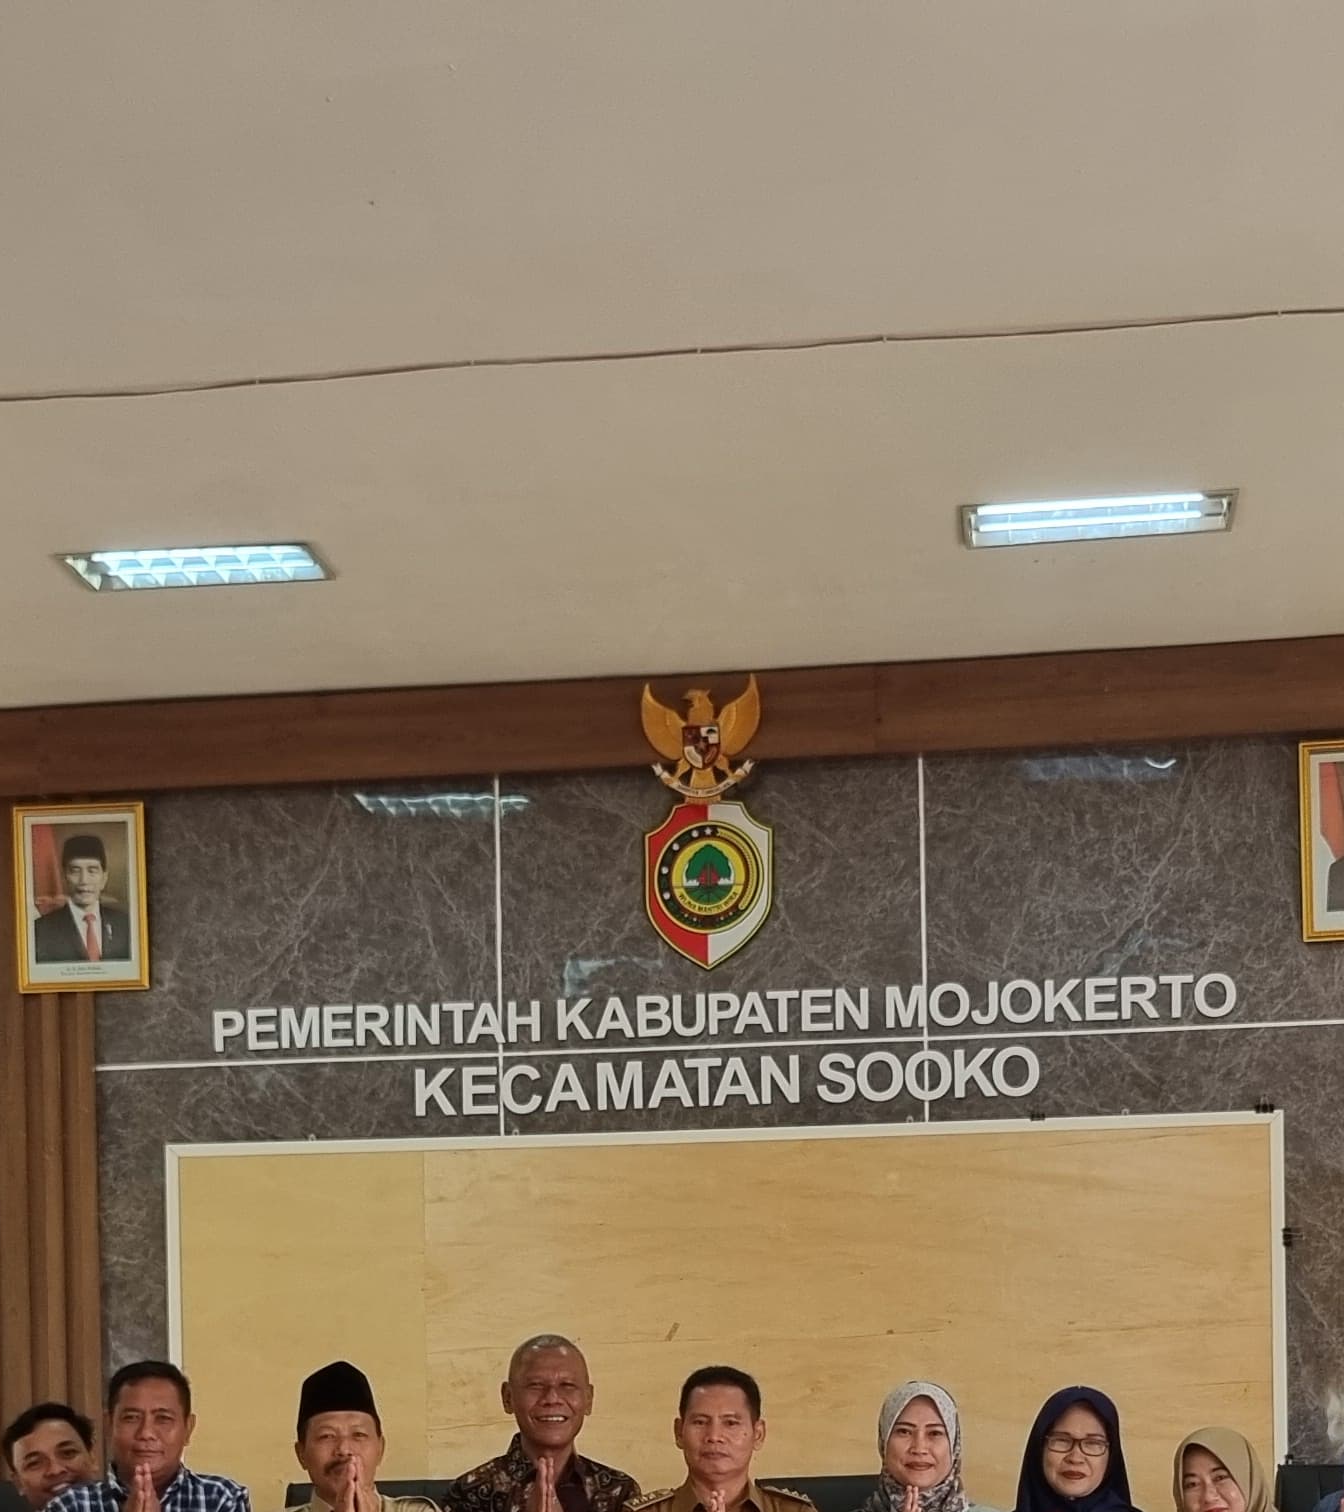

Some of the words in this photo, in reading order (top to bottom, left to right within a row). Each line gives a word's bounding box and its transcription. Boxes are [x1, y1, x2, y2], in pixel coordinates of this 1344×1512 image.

[213, 1000, 541, 1052] PEMERINTAH
[557, 987, 869, 1041] KABUPATEN
[885, 973, 1237, 1029] MOJOKERTO
[415, 1054, 801, 1117] KECAMATAN
[816, 1046, 1040, 1104] SOOKO
